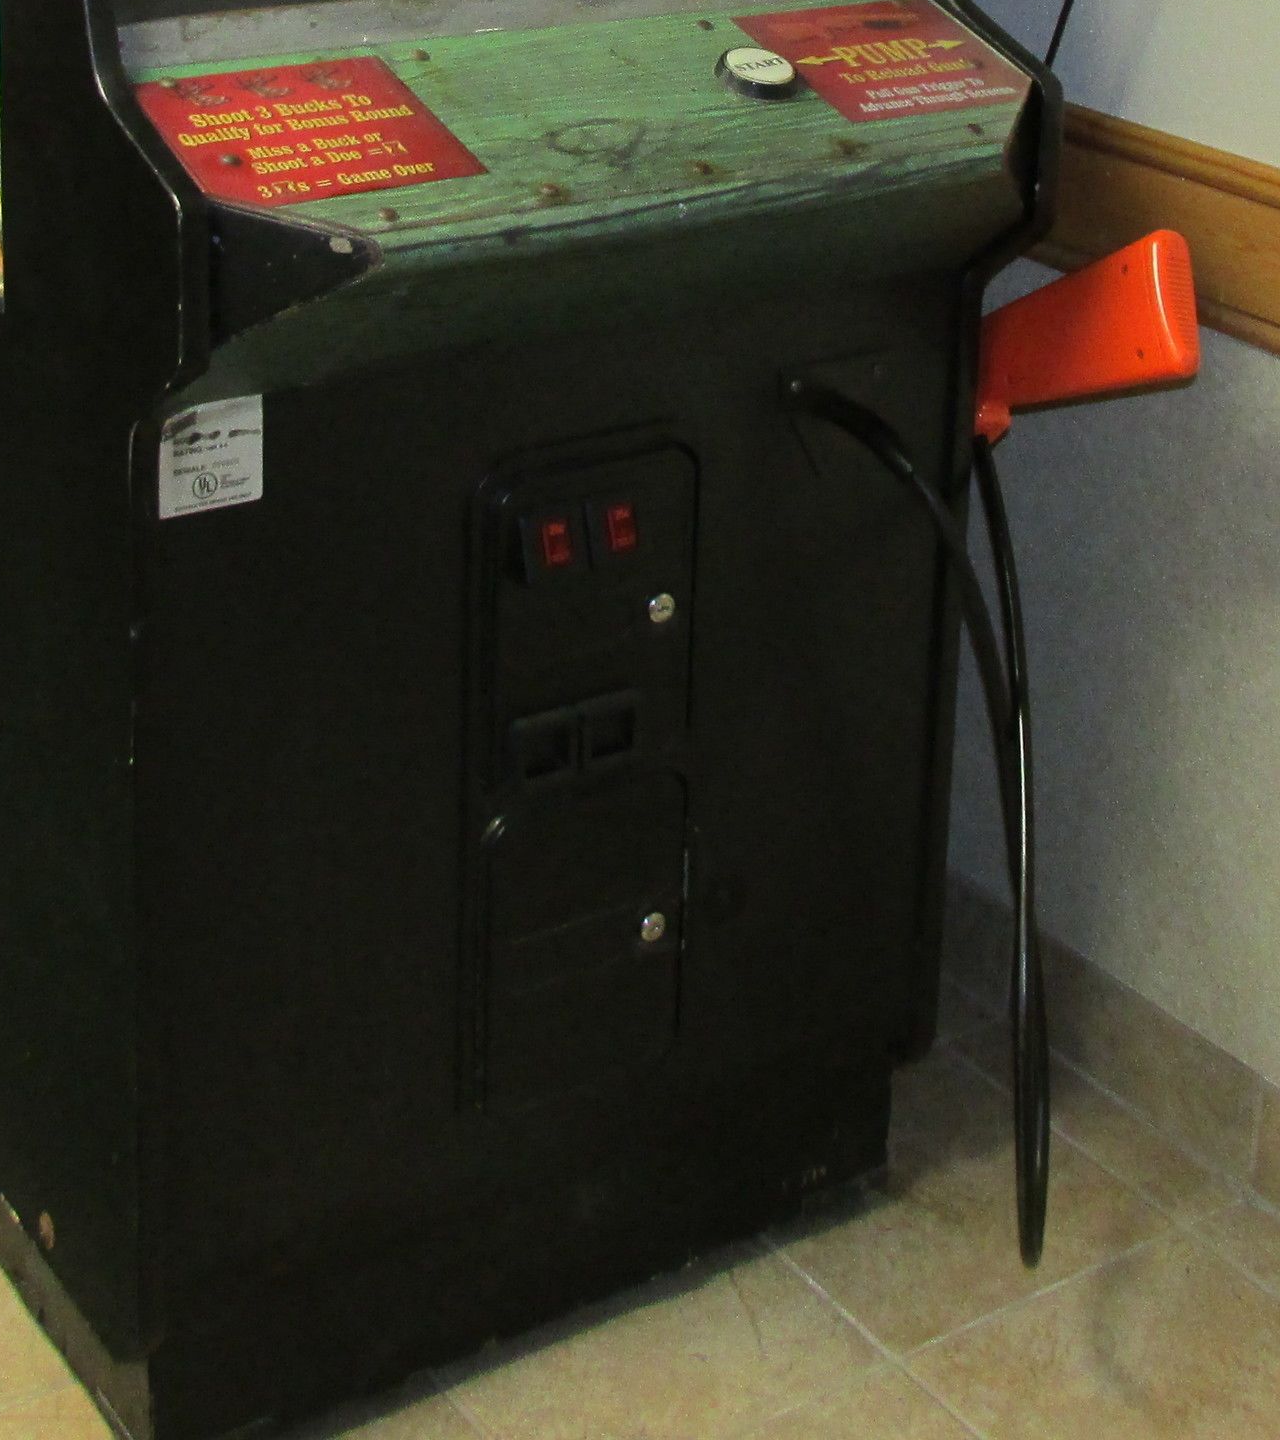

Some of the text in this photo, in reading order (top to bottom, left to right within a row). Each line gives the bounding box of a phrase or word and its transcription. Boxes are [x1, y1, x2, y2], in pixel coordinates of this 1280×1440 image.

[733, 57, 784, 72] START
[831, 38, 931, 68] PUMP
[839, 72, 867, 85] To
[864, 64, 927, 81] Reload
[189, 94, 372, 128] Shoot 3 Bucks To
[178, 104, 416, 147] Qualify for Bonus Round
[246, 132, 384, 159] Miss a Buck or
[251, 158, 308, 175] Shoot
[310, 156, 326, 166] a
[324, 151, 363, 163] Doe
[336, 169, 392, 185] Game
[393, 163, 434, 177] Over
